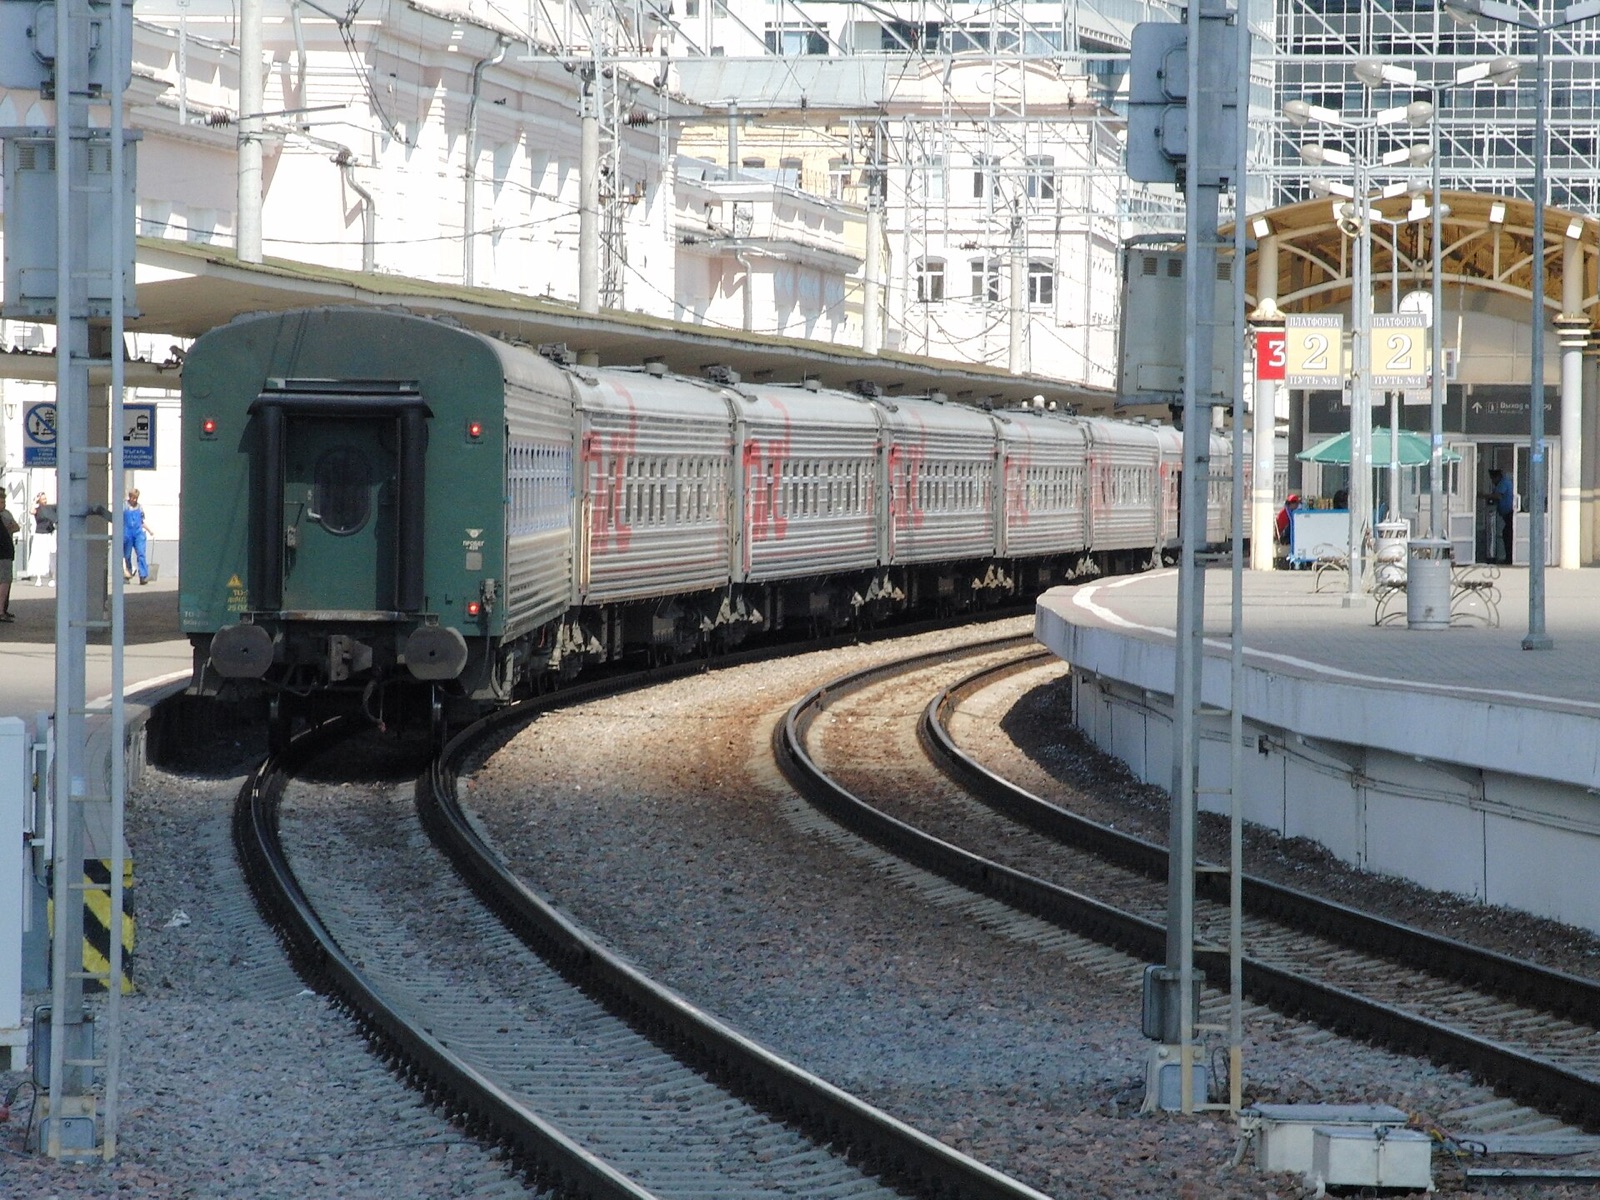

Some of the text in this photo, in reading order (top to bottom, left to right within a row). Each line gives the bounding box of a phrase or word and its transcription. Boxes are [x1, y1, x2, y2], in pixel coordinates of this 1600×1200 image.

[1289, 316, 1339, 327] ПЛАТФОРМА
[1373, 316, 1423, 327] ПЛАТФОРМА
[1268, 340, 1286, 367] 3
[1301, 333, 1329, 370] 2
[1385, 333, 1413, 370] 2
[1289, 376, 1319, 385] ПУТЬ
[1373, 376, 1403, 385] ПУТЬ
